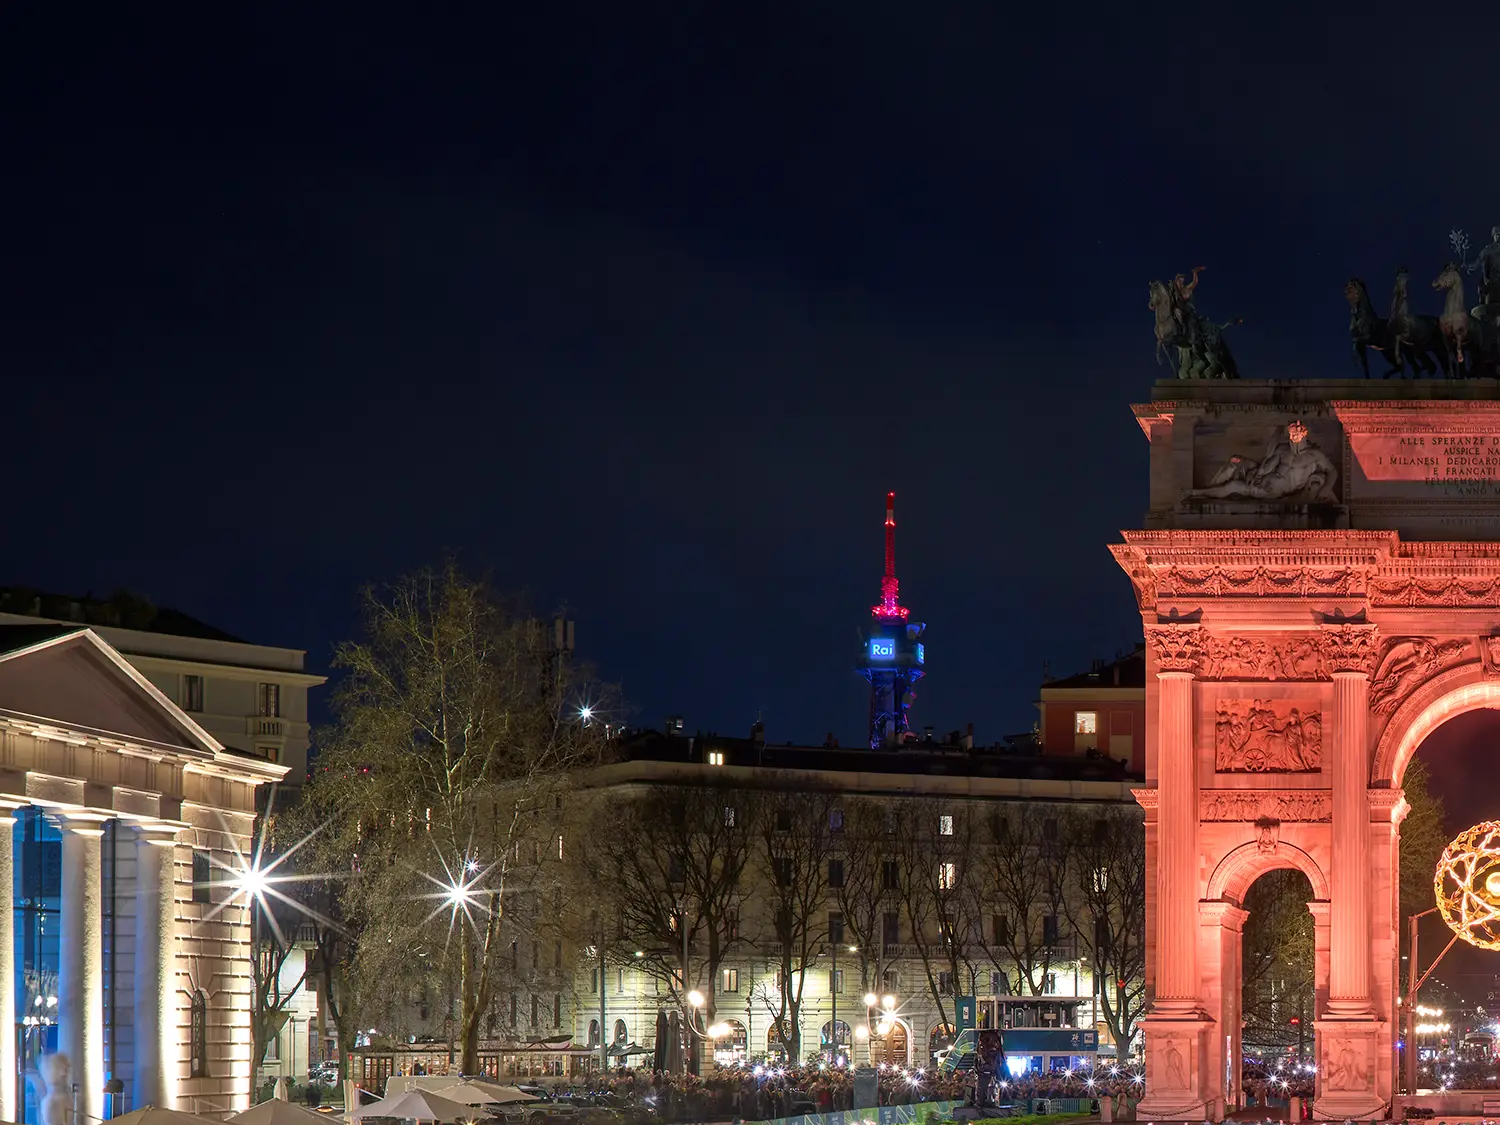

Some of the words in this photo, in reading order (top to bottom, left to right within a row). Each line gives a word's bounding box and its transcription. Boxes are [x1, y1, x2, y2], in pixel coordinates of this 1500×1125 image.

[1399, 437, 1425, 446] ALLE
[1432, 437, 1485, 446] SPERANZE
[1443, 447, 1480, 456] AUSPICE
[1378, 456, 1383, 466] I
[1389, 456, 1439, 466] MILANESI
[1433, 467, 1438, 476] E
[1445, 467, 1496, 476] FRANCATI
[1425, 477, 1493, 486] FELICEMENTE
[872, 643, 893, 655] Rai
